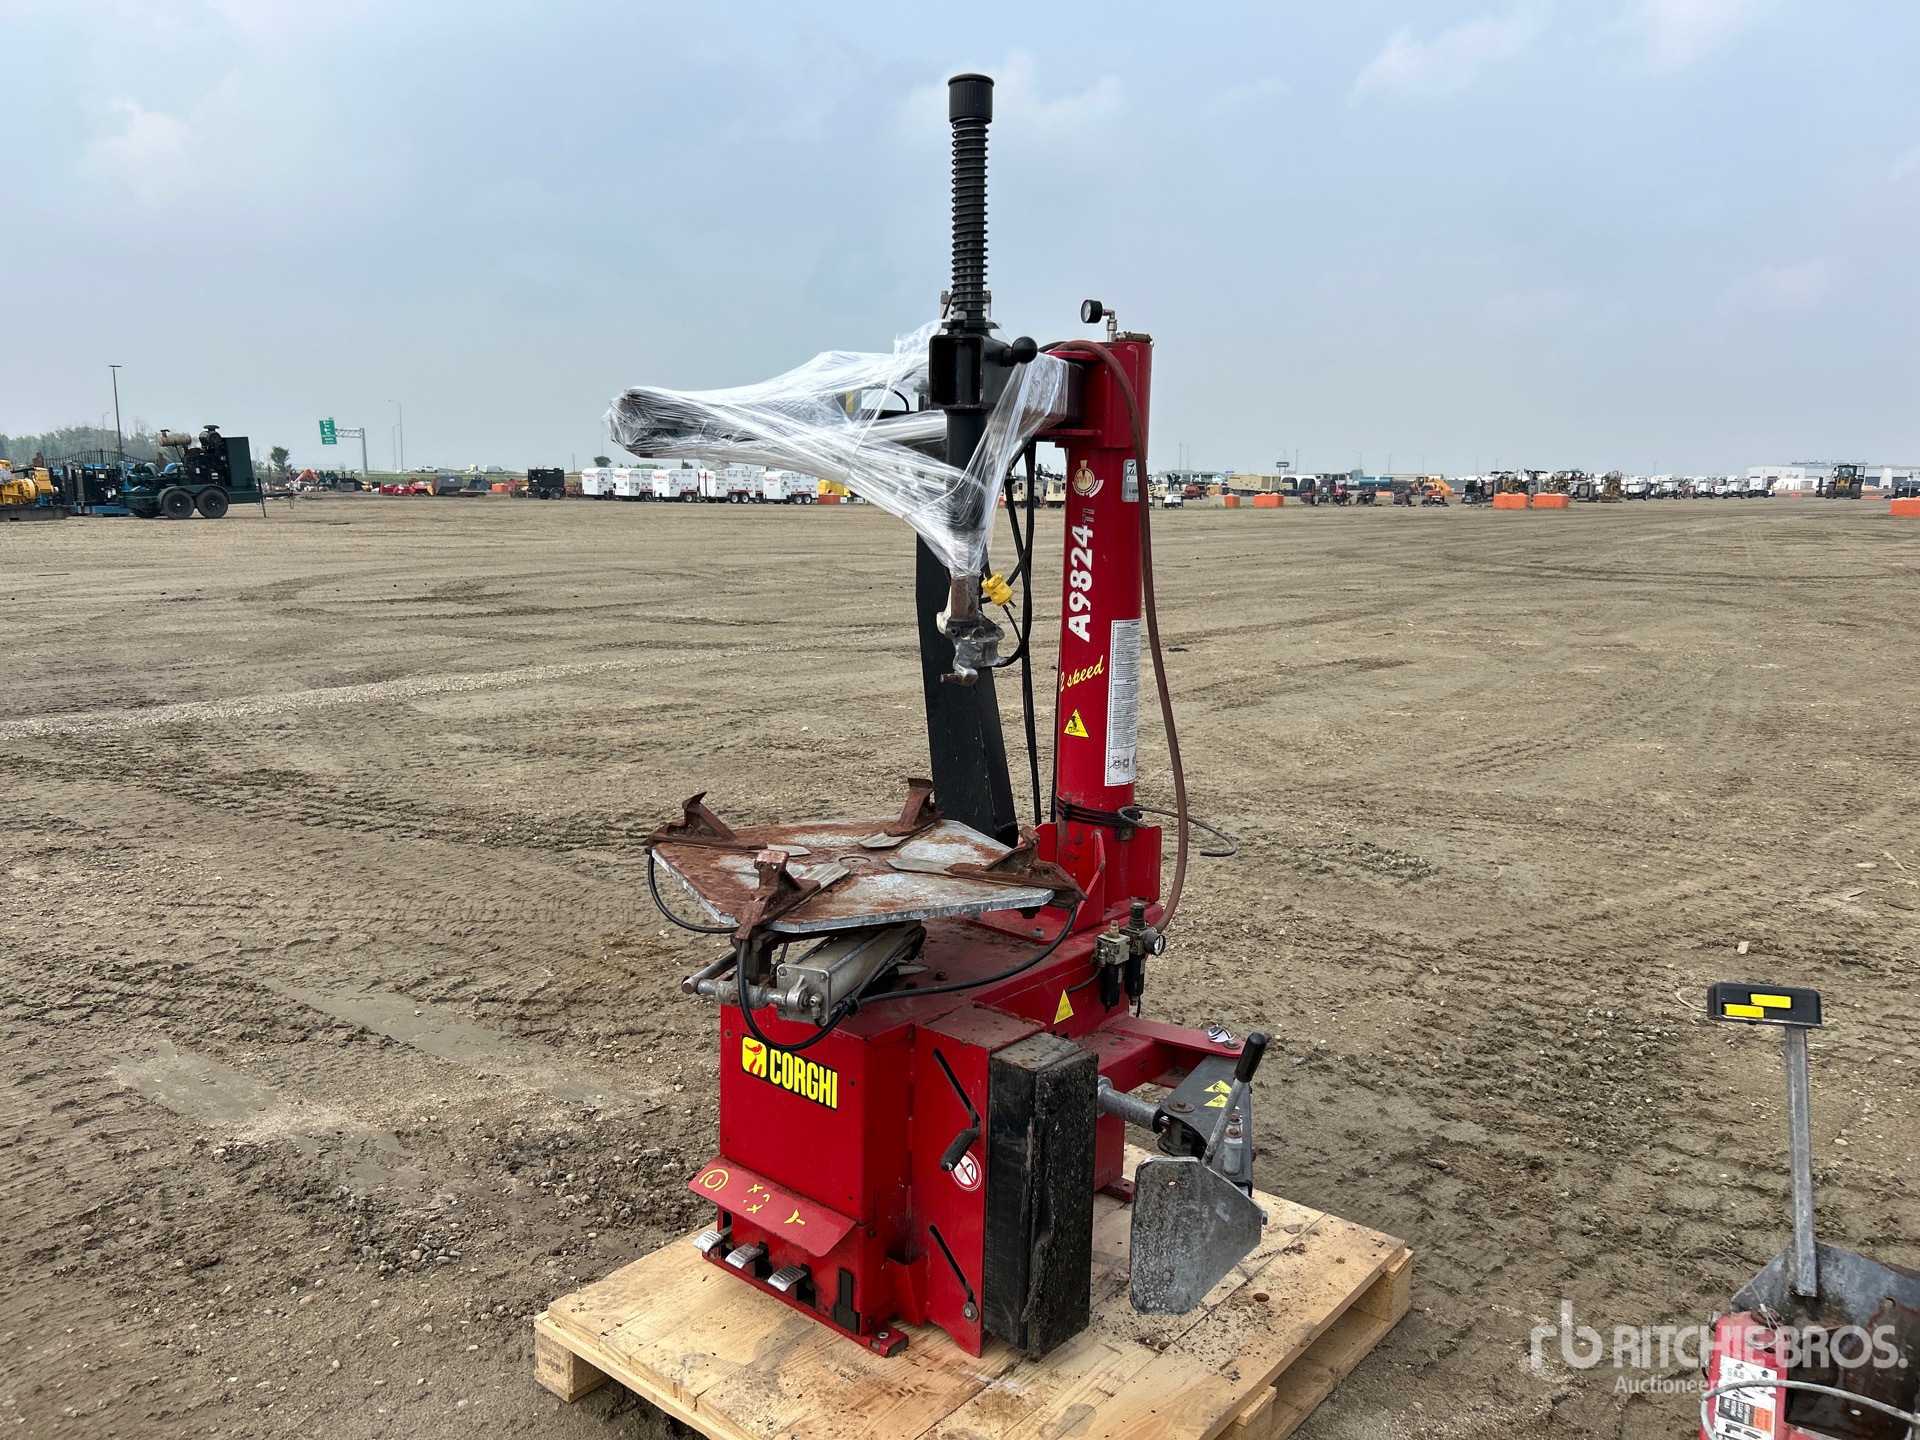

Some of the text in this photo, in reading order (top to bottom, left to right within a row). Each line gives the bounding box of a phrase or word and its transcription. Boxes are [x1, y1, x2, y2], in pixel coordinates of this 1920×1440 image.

[1068, 525, 1094, 643] A9824
[1067, 654, 1105, 688] speed
[769, 1048, 838, 1109] CORGHI
